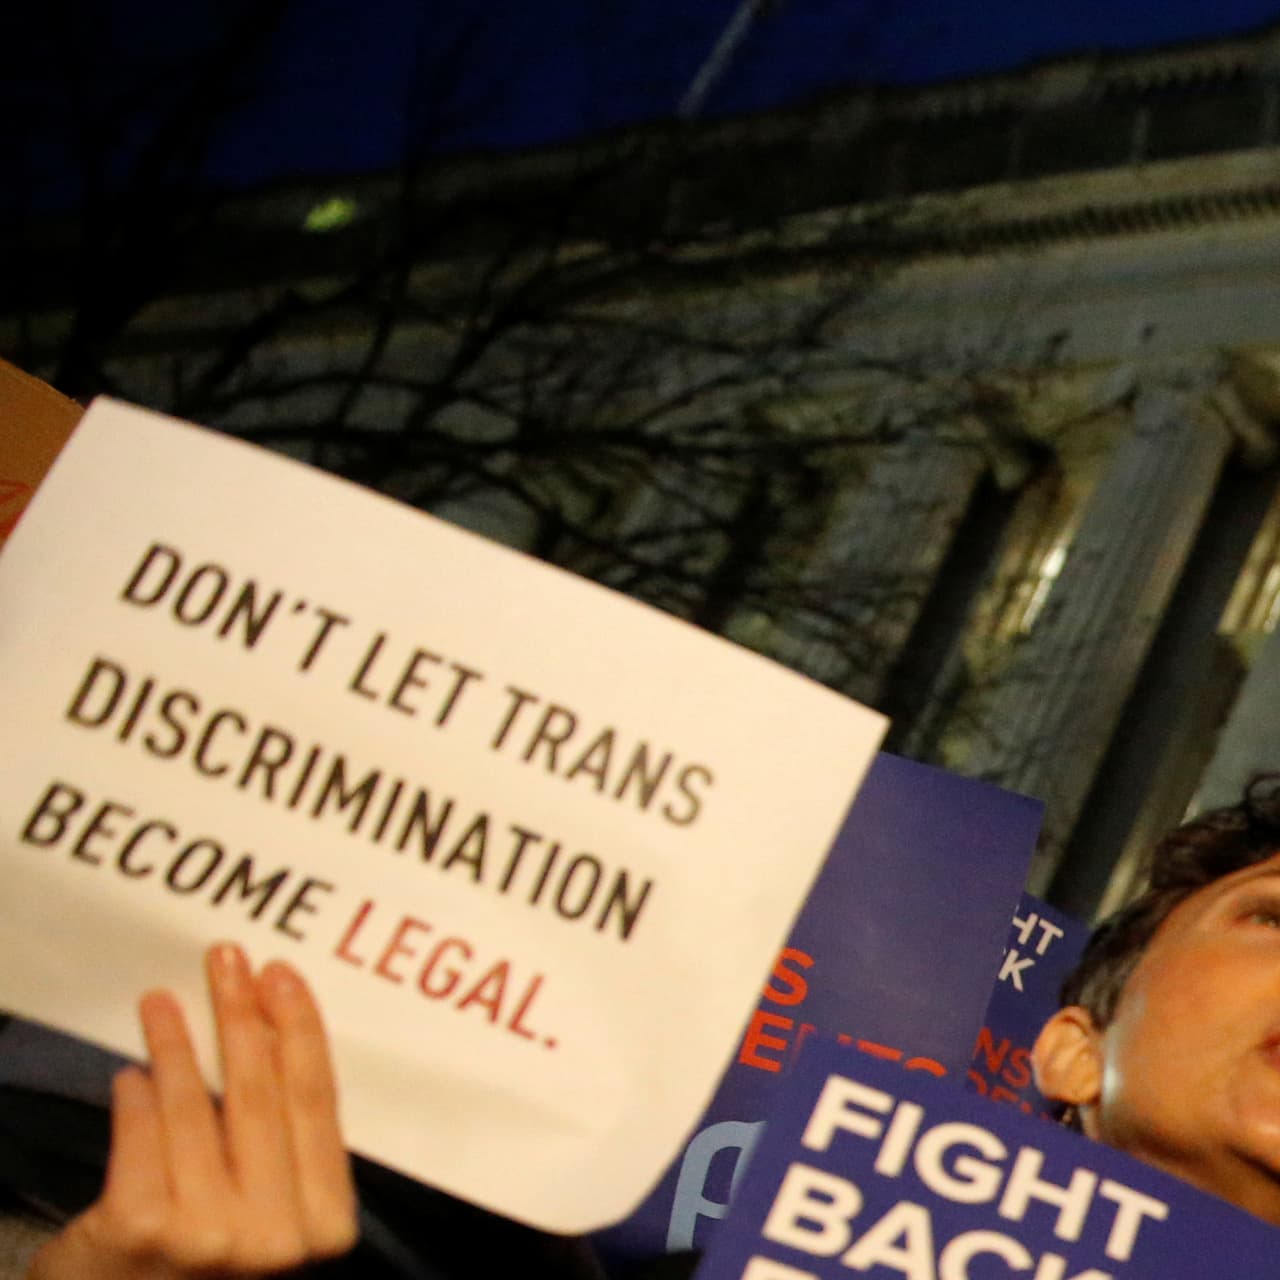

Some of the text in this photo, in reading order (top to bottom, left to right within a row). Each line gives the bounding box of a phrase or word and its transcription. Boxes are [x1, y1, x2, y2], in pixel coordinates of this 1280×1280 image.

[66, 657, 655, 943] DISCRIMINATION
[121, 543, 715, 829] DON'T LET TRANS
[19, 781, 336, 942] BECOME
[335, 899, 560, 1050] LEGAL.
[801, 1074, 1169, 1264] FIGHT
